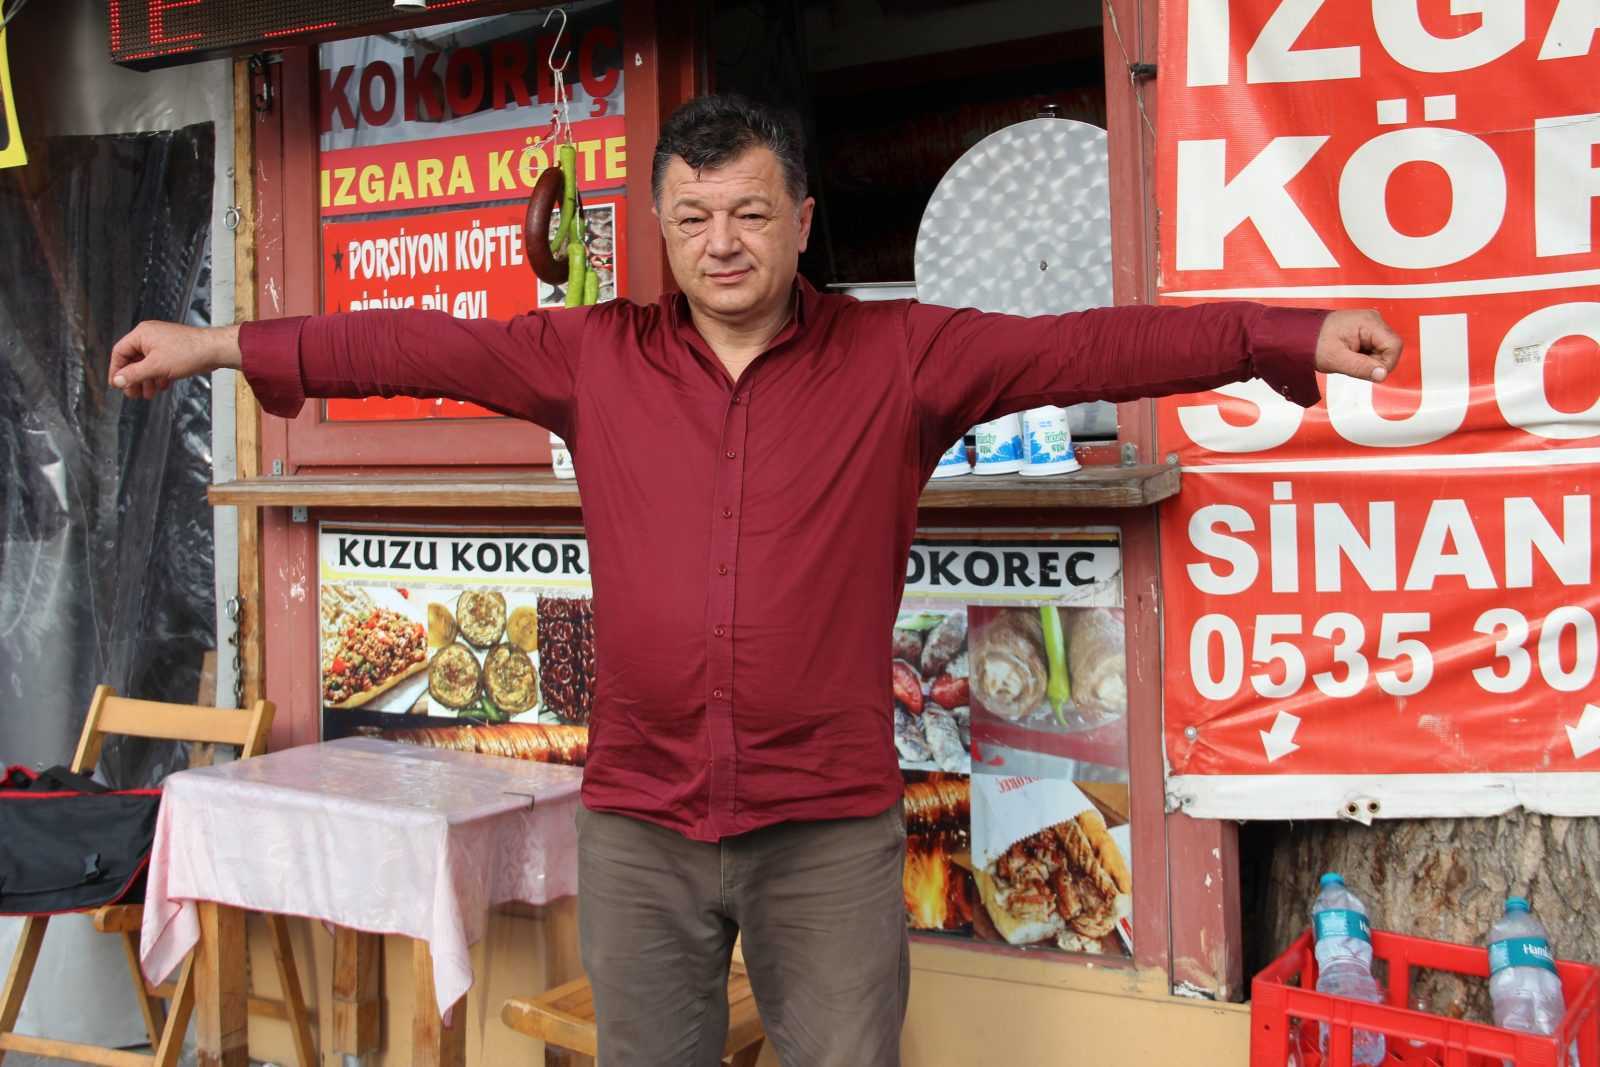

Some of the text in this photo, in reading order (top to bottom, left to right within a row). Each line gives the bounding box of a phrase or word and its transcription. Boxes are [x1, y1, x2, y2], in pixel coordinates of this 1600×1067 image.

[318, 24, 622, 132] KOKOREÇ
[320, 153, 475, 208] IZGARA
[348, 219, 524, 281] PORSİYON KÖFTE
[338, 537, 591, 575] KUZU KOKOR
[1186, 481, 1592, 596] SİNAN
[1189, 605, 1599, 701] 0535 30
